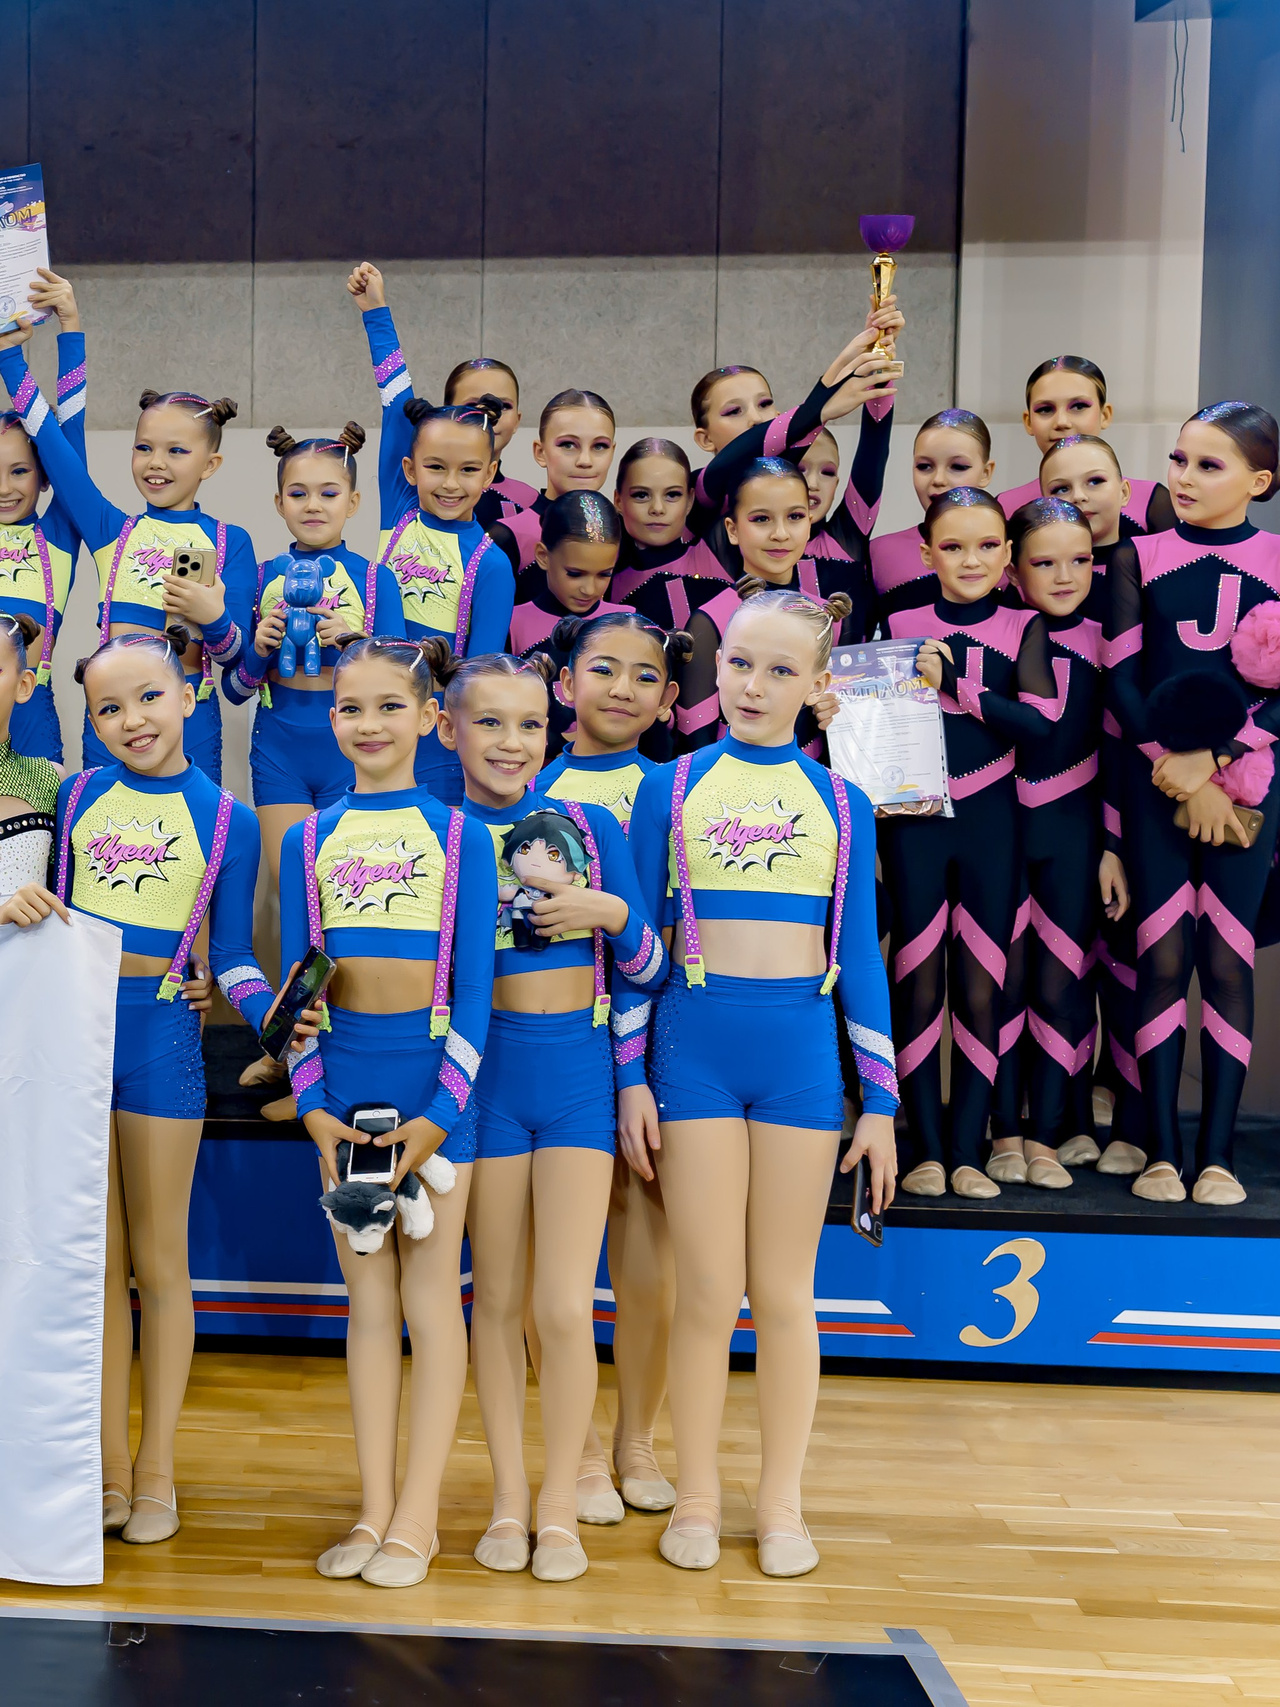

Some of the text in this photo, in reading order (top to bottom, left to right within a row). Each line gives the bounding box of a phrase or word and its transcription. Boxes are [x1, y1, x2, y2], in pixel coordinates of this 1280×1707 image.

[133, 547, 173, 576] Иде
[392, 553, 449, 585] Идеал
[1177, 573, 1242, 652] J
[86, 833, 168, 874] Идеал
[704, 816, 795, 857] Идеал
[329, 856, 414, 898] Идеал
[959, 1238, 1046, 1347] 3
